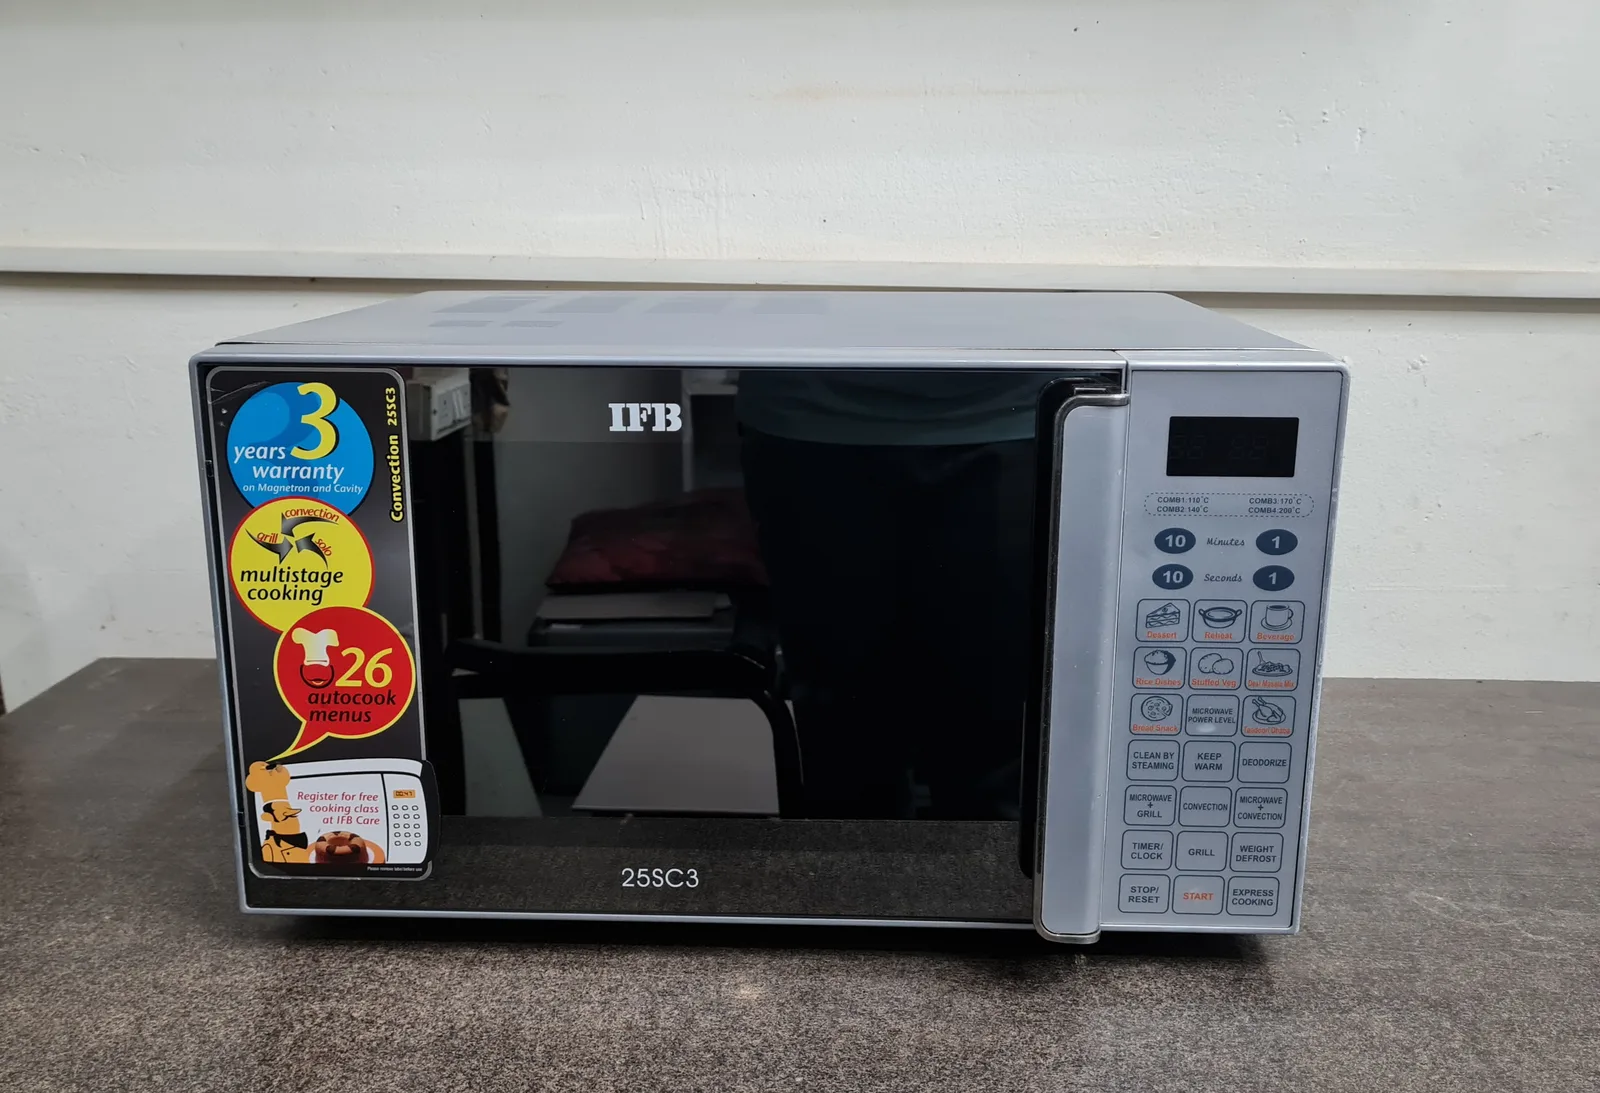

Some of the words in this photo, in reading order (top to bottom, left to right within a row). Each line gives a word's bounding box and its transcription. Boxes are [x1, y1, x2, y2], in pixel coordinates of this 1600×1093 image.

[385, 387, 398, 426] 25SC3
[290, 382, 336, 460] 3
[608, 403, 682, 432] IFB
[234, 444, 286, 464] years
[252, 464, 344, 484] warranty
[386, 435, 404, 522] Convection
[258, 484, 310, 494] Magnetron
[312, 484, 331, 492] and
[334, 484, 363, 494] Cavity
[285, 508, 340, 522] convection
[256, 531, 278, 544] grill
[1165, 534, 1186, 548] 10
[1206, 538, 1244, 546] Minutes
[1272, 536, 1280, 548] 1
[315, 538, 332, 556] solo
[240, 566, 344, 588] multistage
[1163, 570, 1184, 584] 10
[1204, 574, 1242, 582] Seconds
[1268, 572, 1277, 584] 1
[248, 584, 323, 606] cooking
[1257, 633, 1294, 642] Beverage
[335, 647, 392, 688] 26
[1222, 680, 1236, 688] Veg
[308, 690, 396, 705] autocook
[309, 710, 371, 722] menus
[297, 791, 338, 802] Register
[341, 792, 356, 801] for
[359, 792, 378, 802] free
[310, 804, 350, 815] cooking
[354, 804, 379, 814] class
[322, 816, 333, 824] at
[336, 816, 352, 824] IFB
[356, 816, 380, 825] Care
[622, 868, 699, 888] 25SC3
[1232, 898, 1274, 906] COOKING
